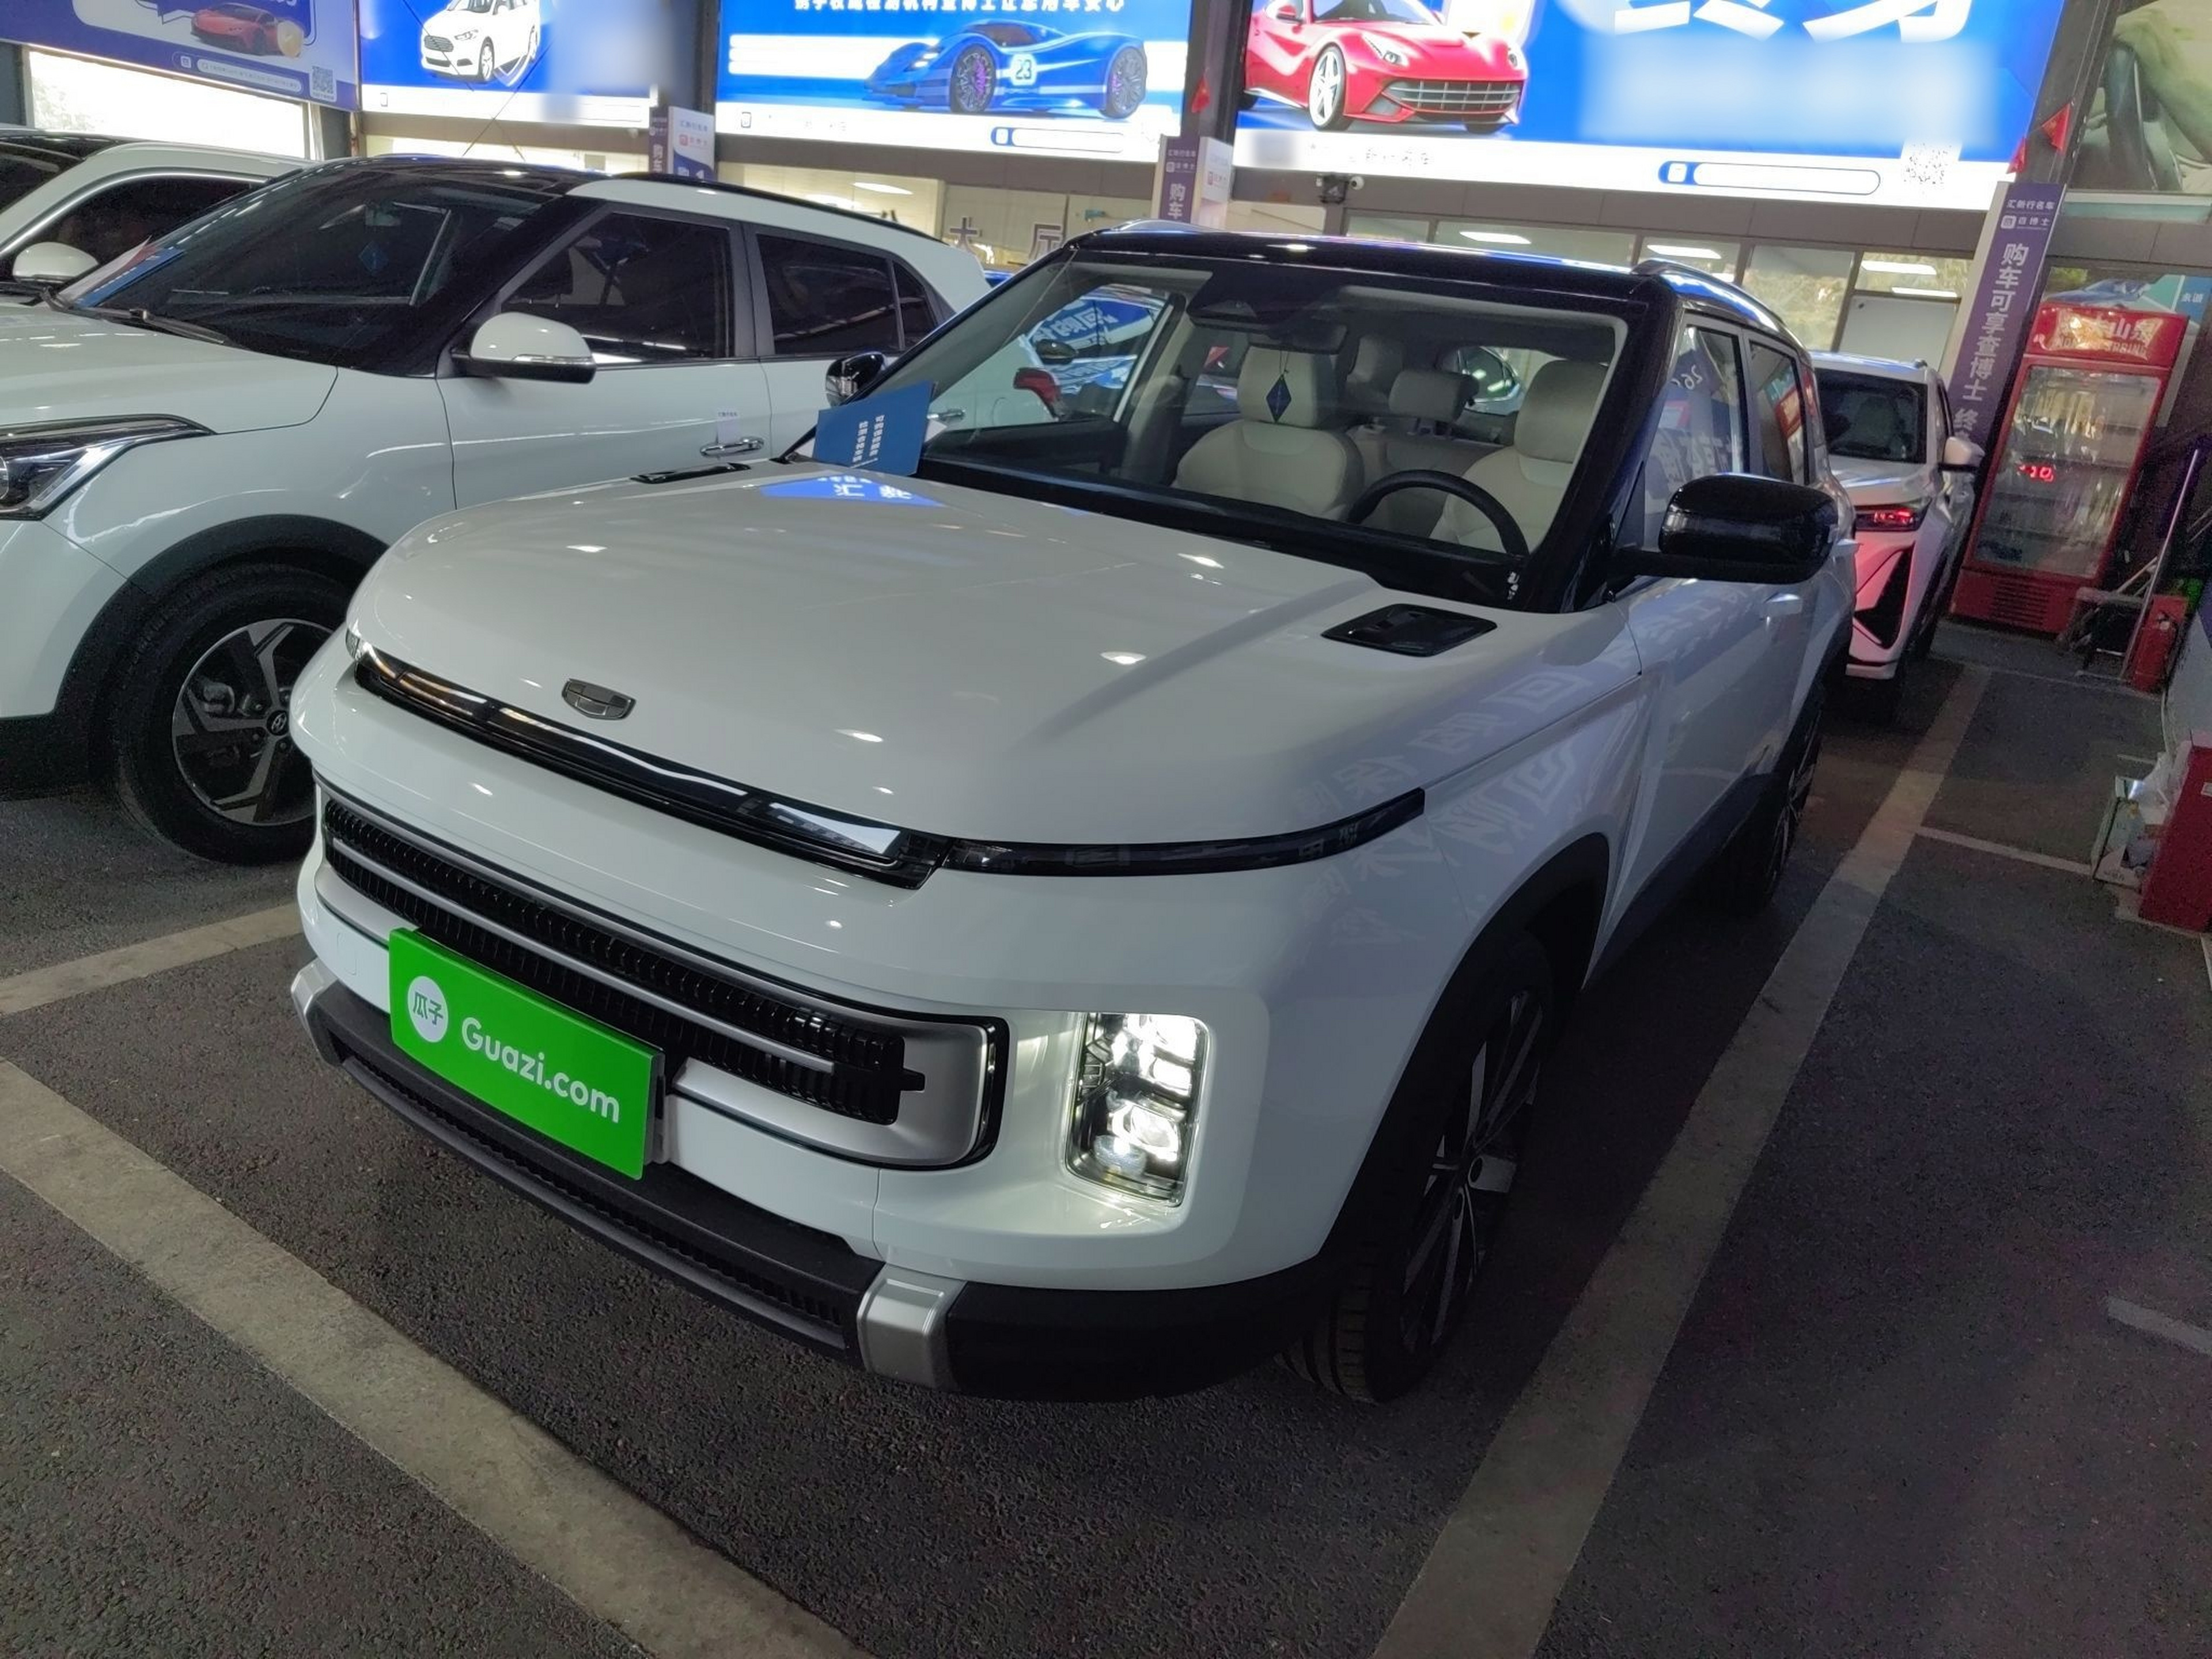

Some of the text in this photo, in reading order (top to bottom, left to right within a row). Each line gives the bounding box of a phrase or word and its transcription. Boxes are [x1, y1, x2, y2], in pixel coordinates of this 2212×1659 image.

[1016, 59, 1032, 80] 23
[1962, 243, 2030, 402] 购车可享查博士
[412, 992, 444, 1025] 瓜子
[461, 1017, 620, 1124] Guazi.com
